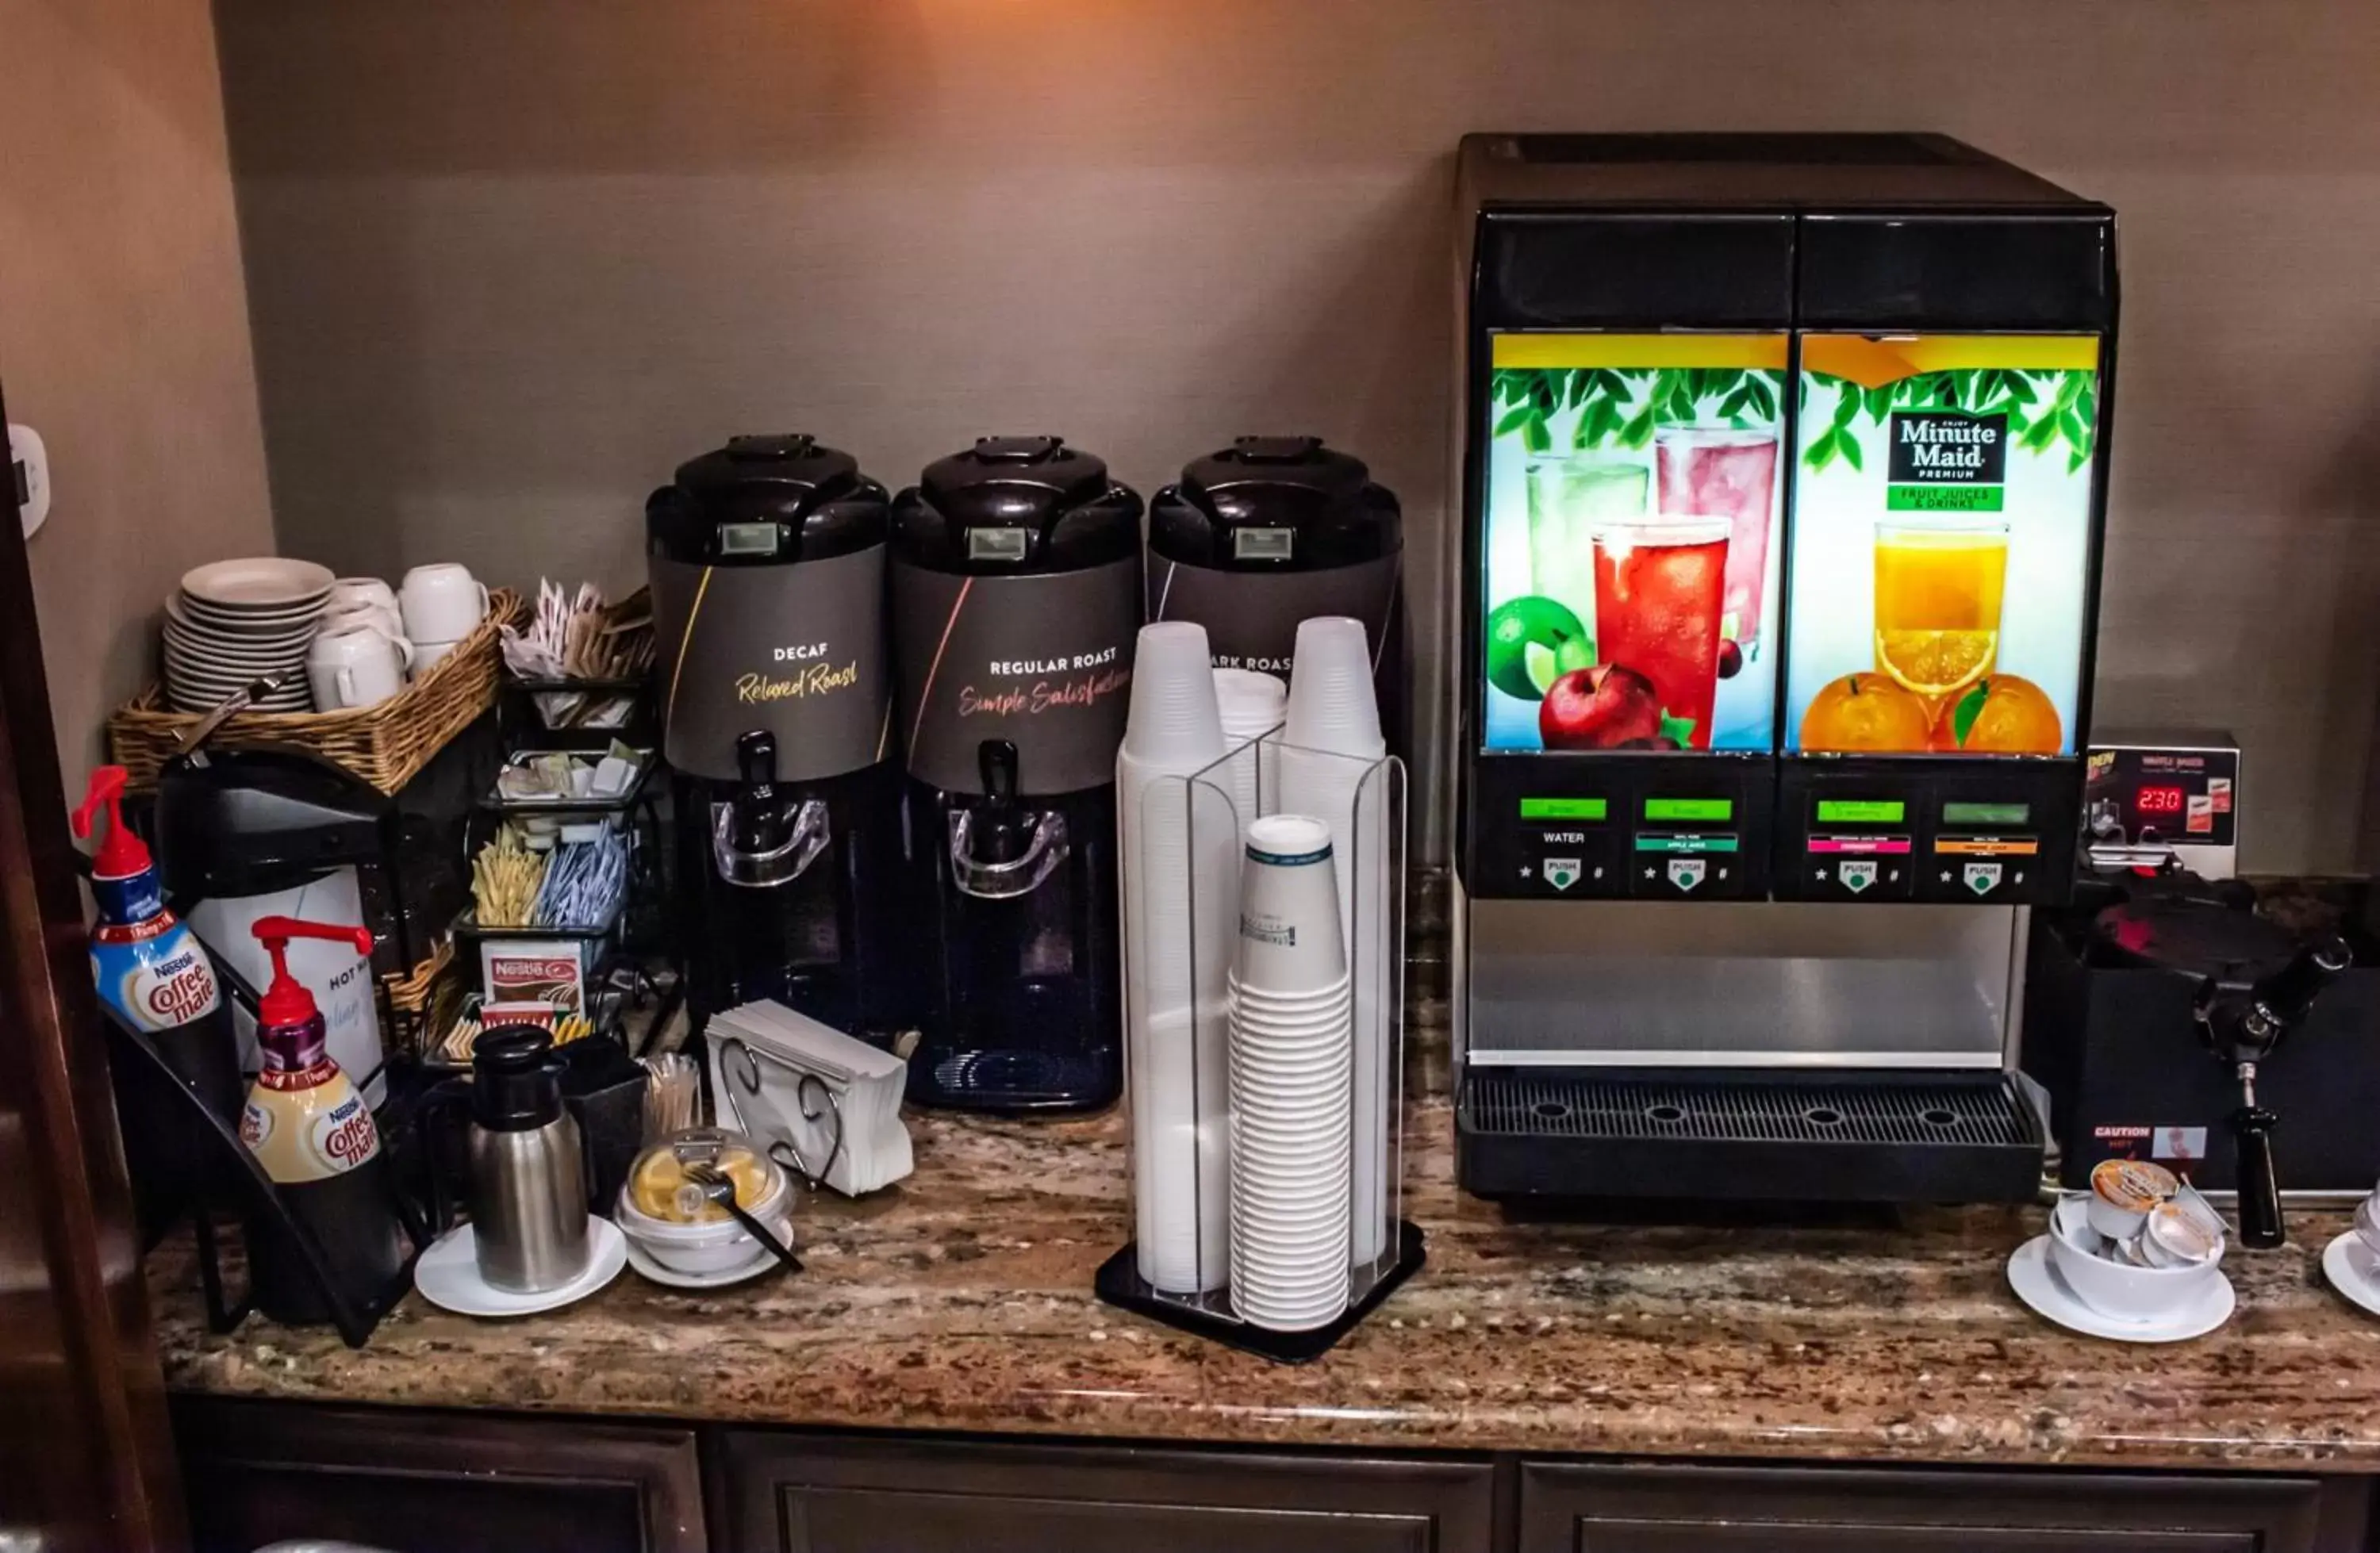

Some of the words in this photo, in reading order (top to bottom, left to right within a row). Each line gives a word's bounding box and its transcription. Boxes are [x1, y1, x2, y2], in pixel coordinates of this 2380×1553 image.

[1900, 420, 1997, 443] Minute
[1912, 443, 1982, 467] Maid
[1919, 470, 1974, 479] PREMIUM
[1901, 489, 1938, 499] FRUIT
[1943, 489, 1989, 500] JUICES
[1927, 499, 1974, 509] DRINKS
[774, 642, 827, 661] DECAF
[990, 658, 1068, 675] REGULAR
[1073, 646, 1117, 669] ROAST
[1211, 654, 1239, 668] ARK
[1246, 658, 1292, 670] ROAS
[807, 660, 857, 695] Roast
[958, 685, 1027, 717] Simple
[1543, 833, 1585, 843] WATER
[1549, 862, 1576, 871] PUSH
[1844, 865, 1871, 873] PUSH
[1969, 866, 1998, 875] PUSH
[330, 967, 355, 990] HOT
[148, 964, 205, 1014] Coffee
[173, 978, 213, 1023] mate
[2094, 1126, 2151, 1137] CAUTION
